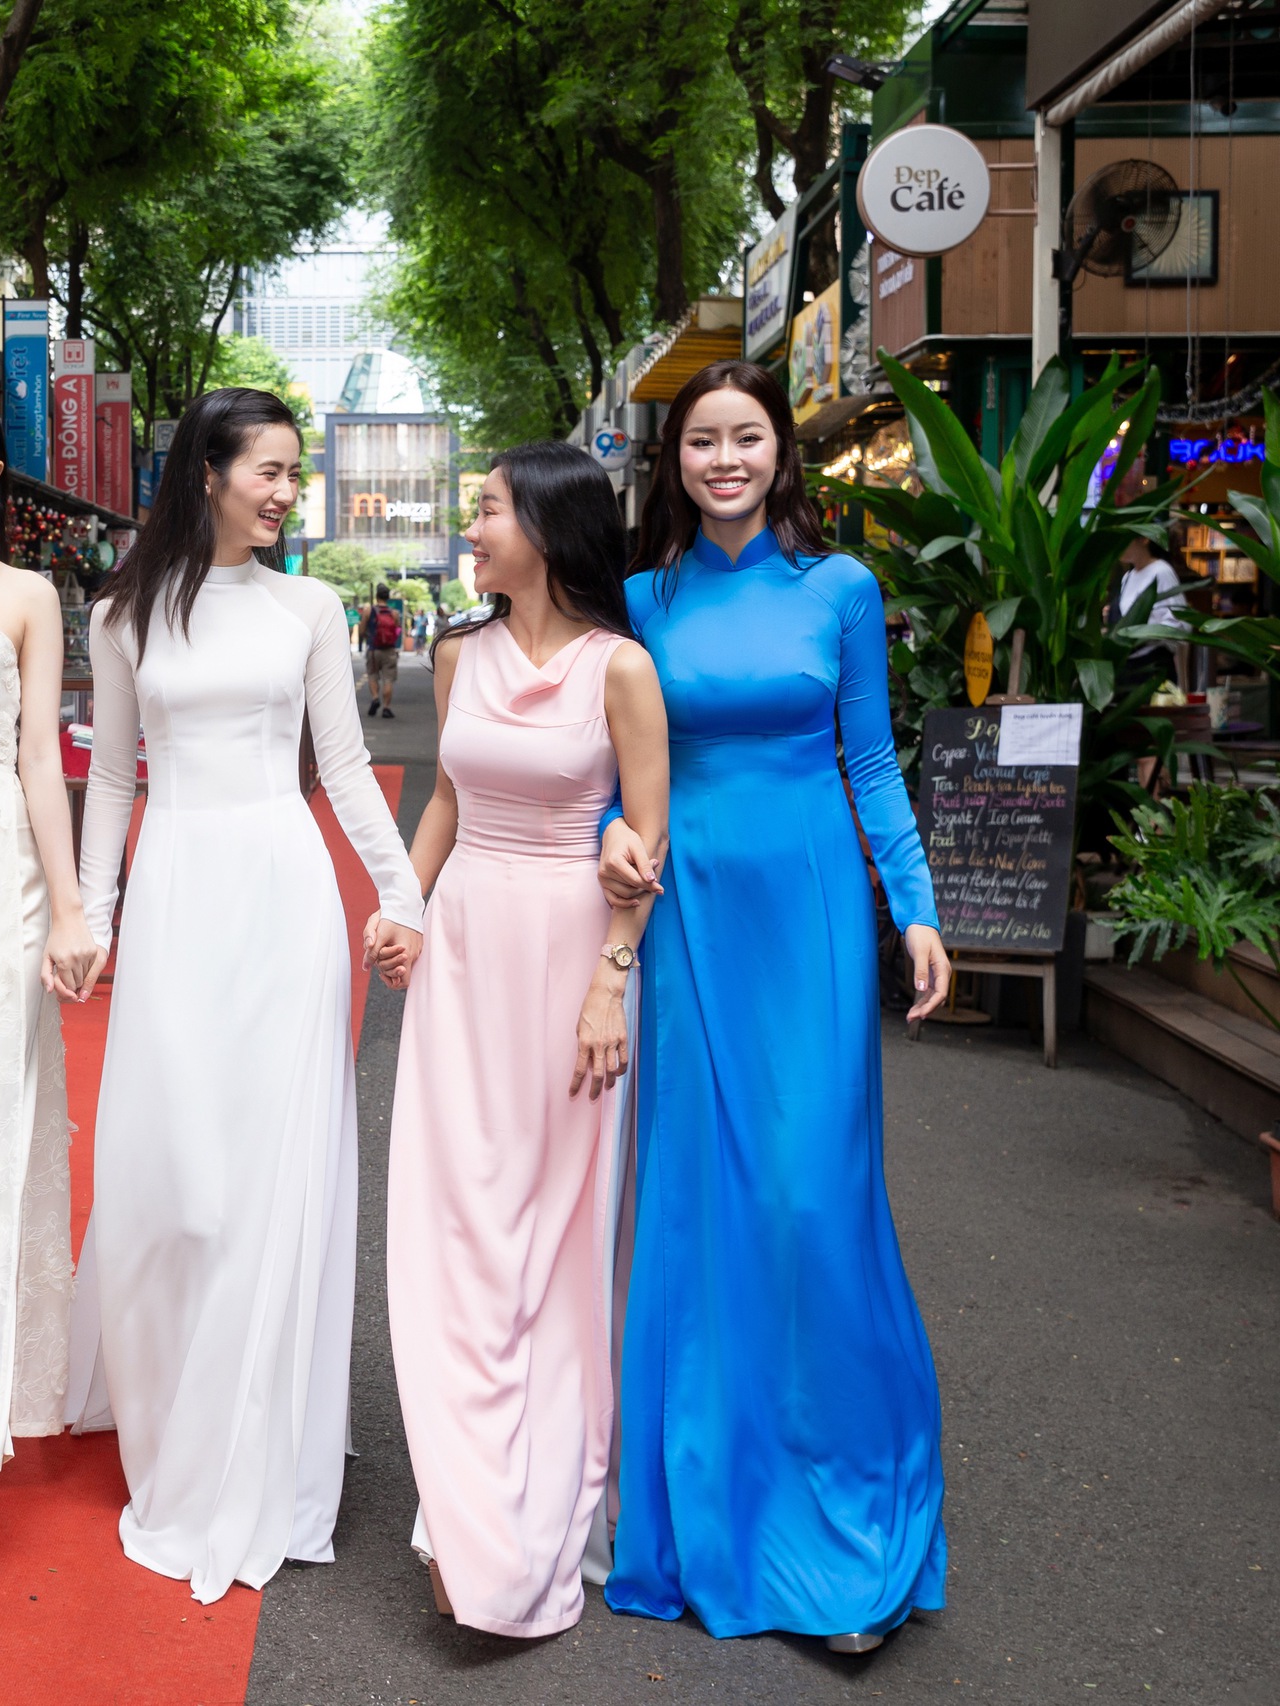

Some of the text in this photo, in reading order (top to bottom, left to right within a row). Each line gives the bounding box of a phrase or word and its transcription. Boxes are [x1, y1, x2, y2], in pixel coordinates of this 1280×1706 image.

[895, 165, 941, 189] Đẹp
[890, 177, 965, 213] Café
[61, 379, 78, 393] A
[58, 399, 78, 459] ĐÔNG
